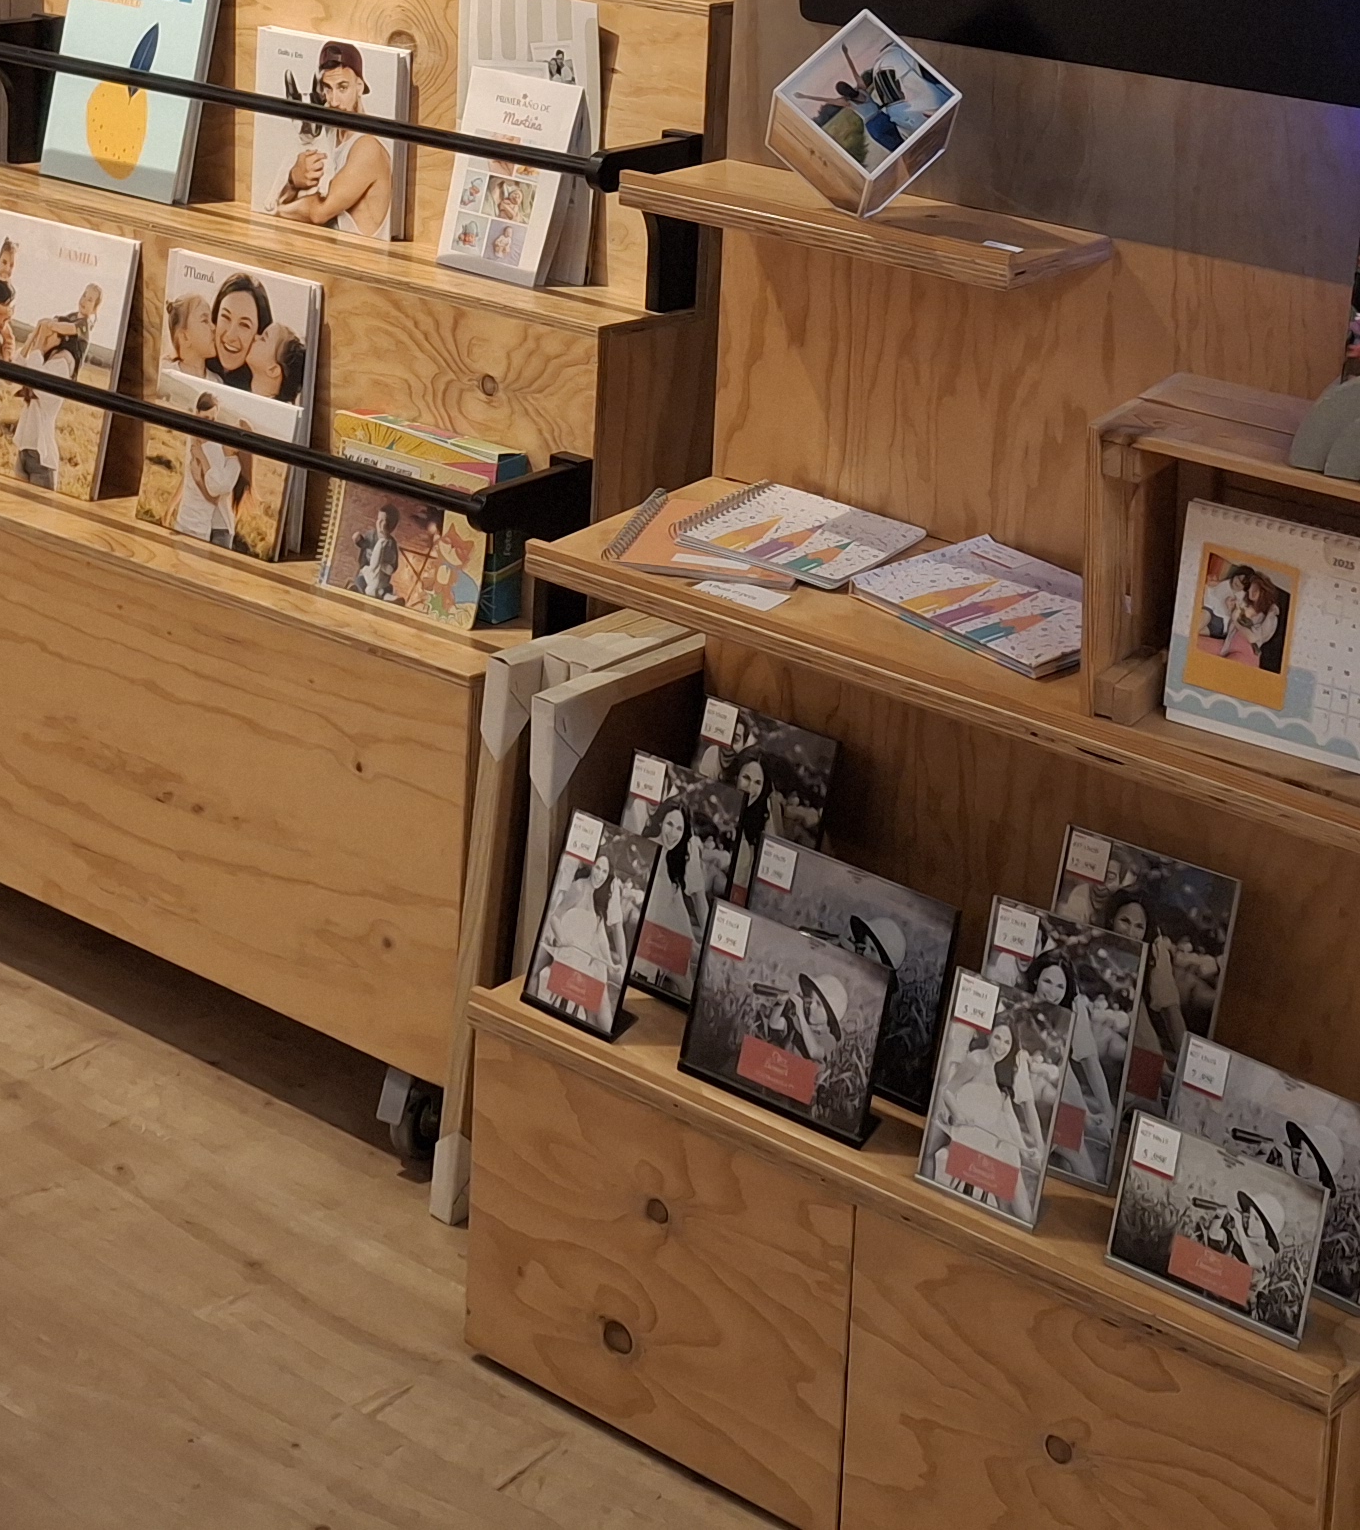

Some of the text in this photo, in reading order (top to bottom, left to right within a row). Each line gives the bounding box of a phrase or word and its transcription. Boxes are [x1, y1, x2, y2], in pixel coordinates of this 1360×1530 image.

[495, 94, 552, 113] PRIMER AÑO DE
[502, 110, 543, 132] Martina
[58, 247, 99, 267] FAMILY
[183, 264, 215, 284] Mamá
